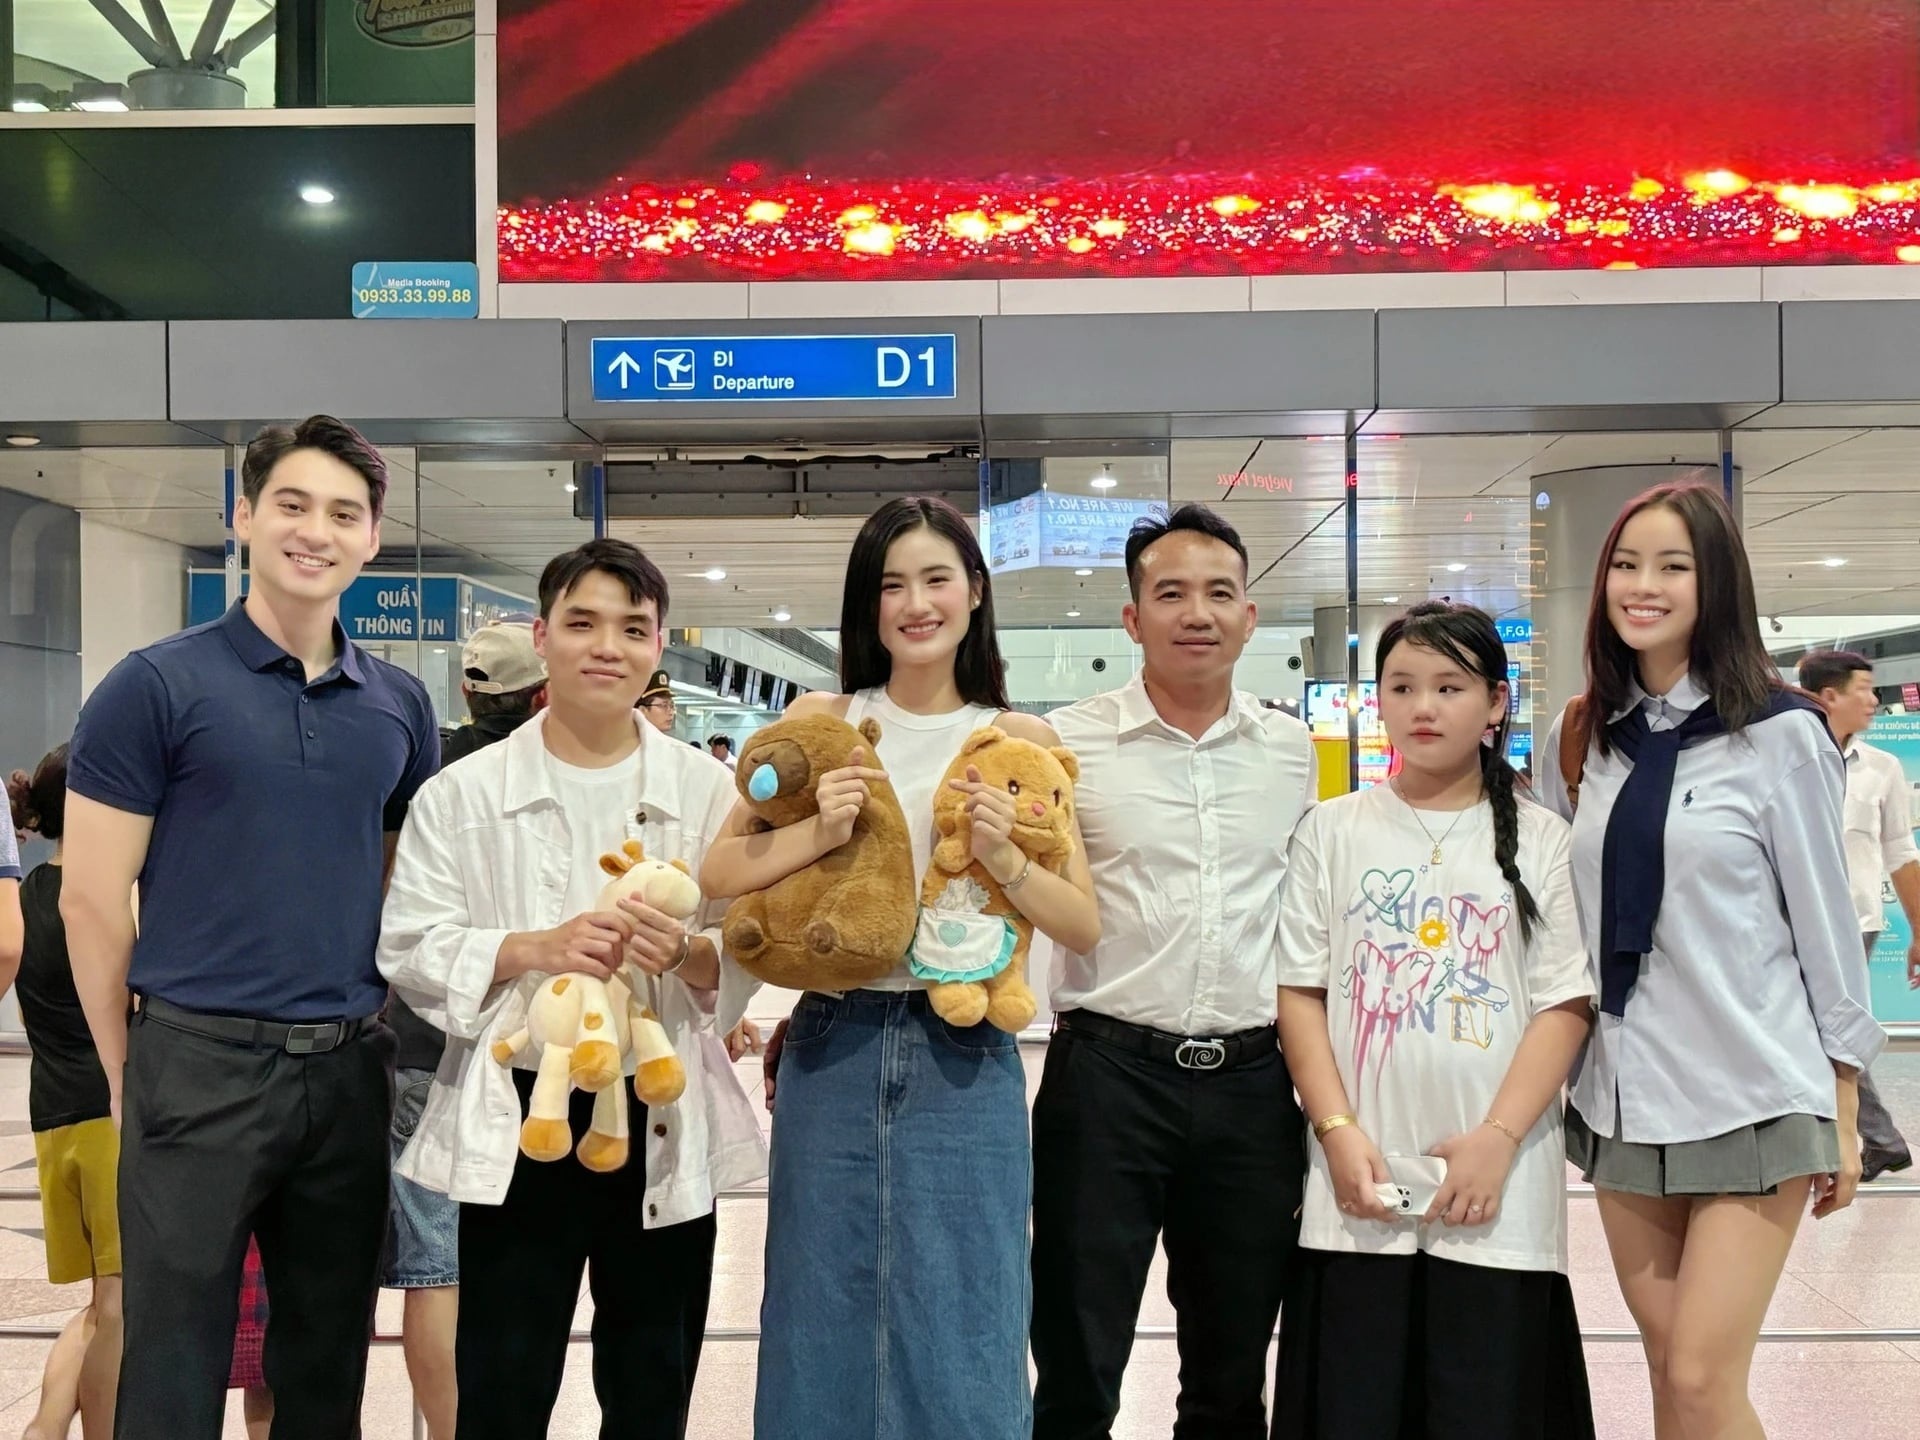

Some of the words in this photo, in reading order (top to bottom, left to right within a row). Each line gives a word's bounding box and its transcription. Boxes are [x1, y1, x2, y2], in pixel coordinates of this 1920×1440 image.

[387, 278, 413, 287] Media
[415, 278, 451, 288] Booking
[360, 289, 471, 303] 0933.33.99.88
[713, 350, 733, 368] ĐI
[877, 346, 935, 388] D1
[713, 375, 795, 392] Departure
[354, 614, 413, 635] THÔNG
